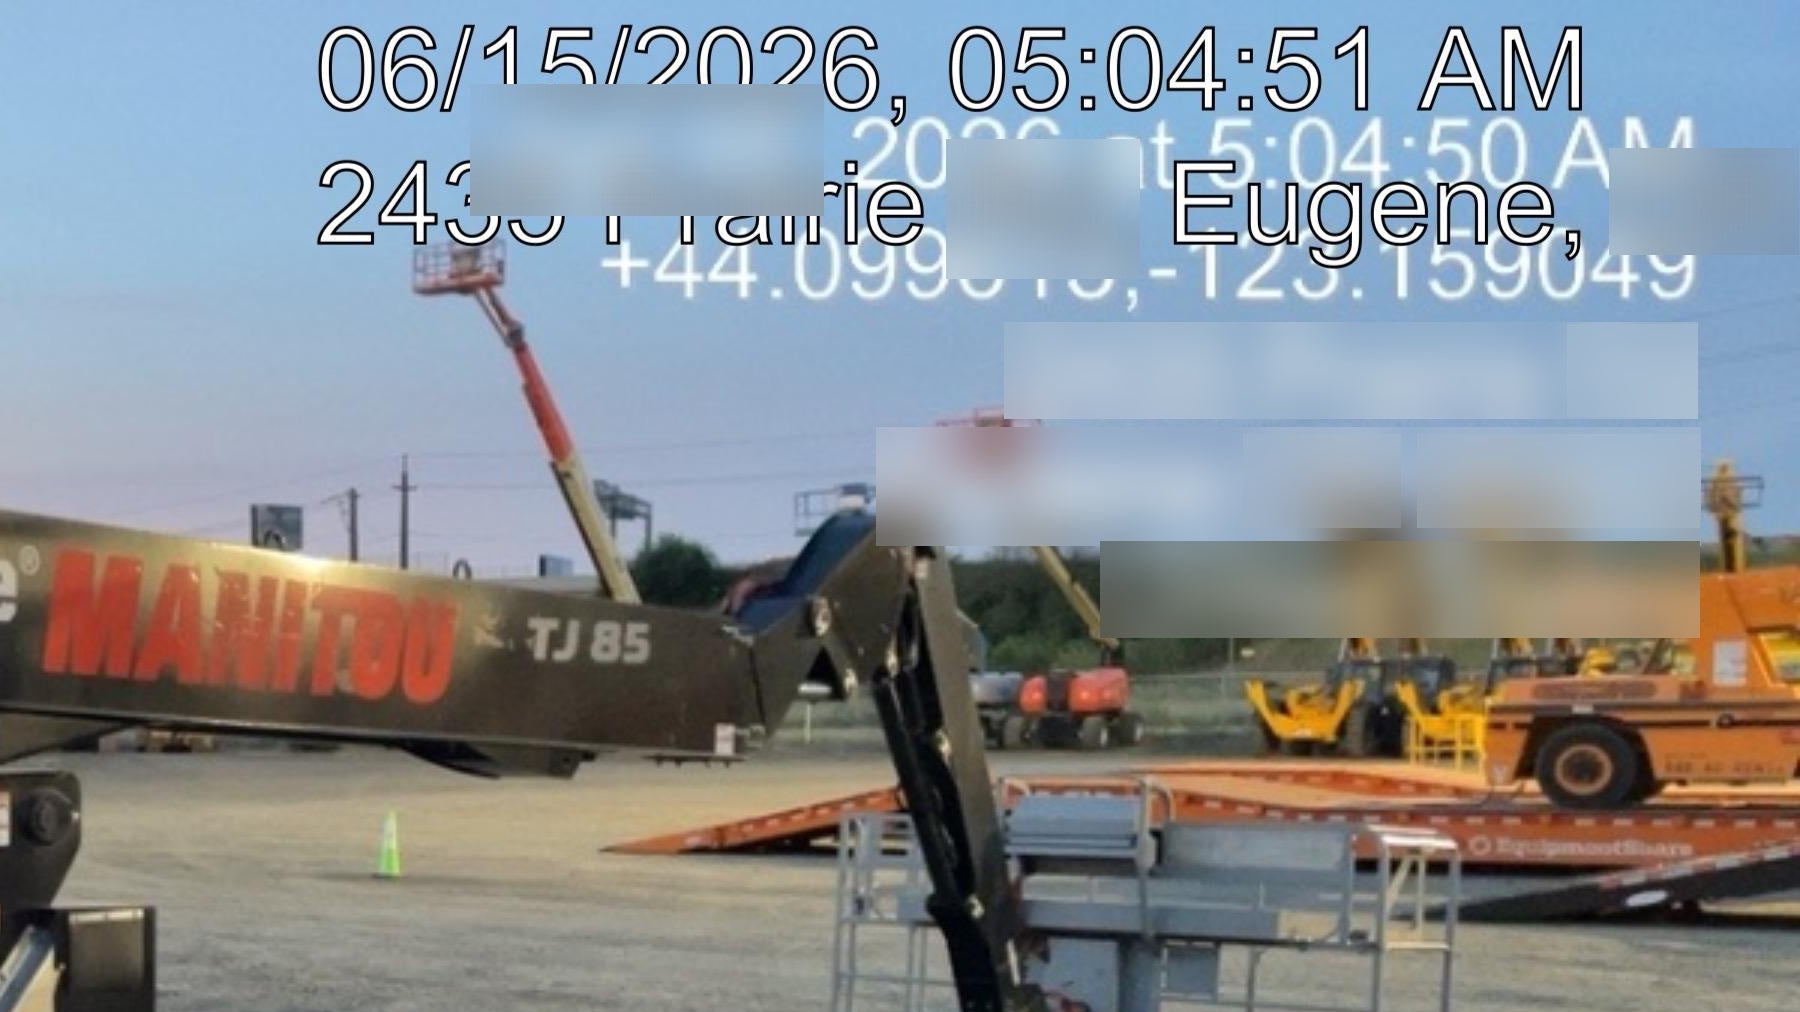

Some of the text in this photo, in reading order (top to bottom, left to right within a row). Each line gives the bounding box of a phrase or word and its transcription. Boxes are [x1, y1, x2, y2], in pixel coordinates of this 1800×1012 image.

[42, 546, 650, 706] MANITOU TJ 85
